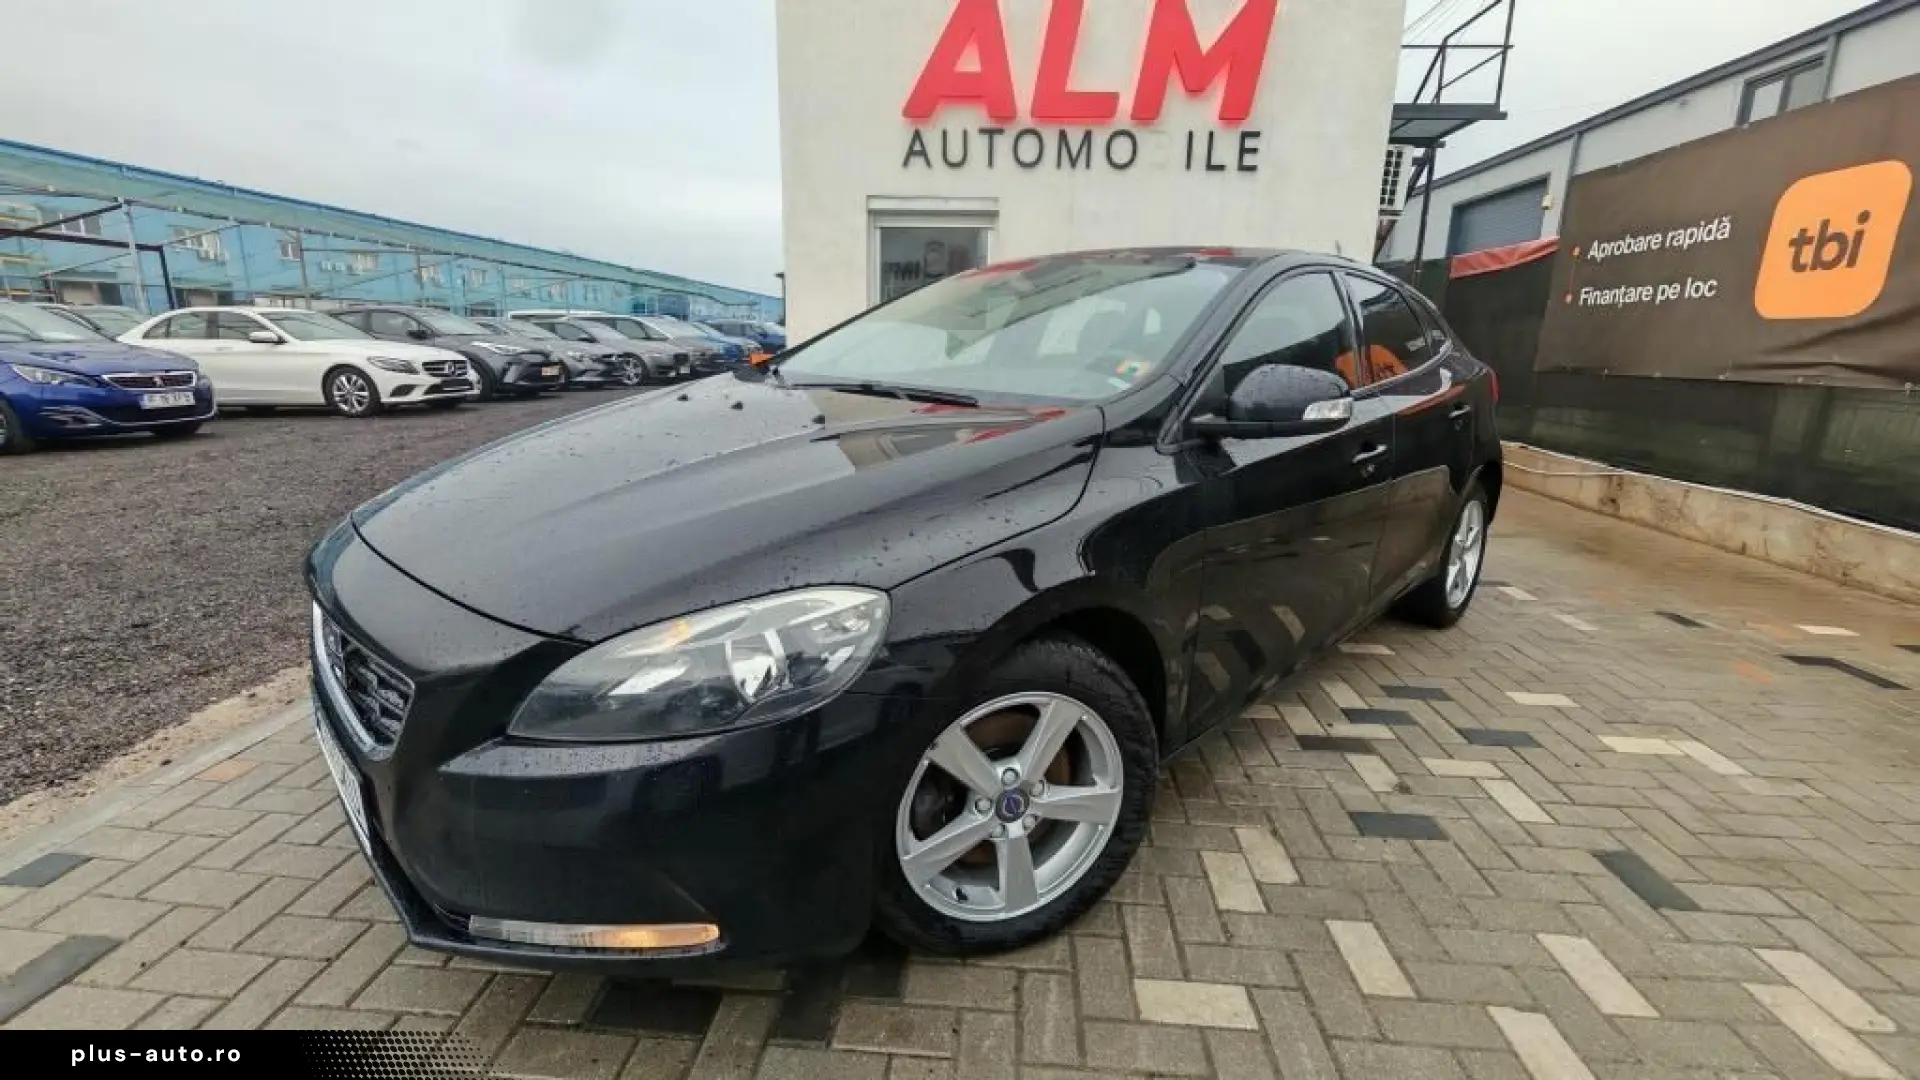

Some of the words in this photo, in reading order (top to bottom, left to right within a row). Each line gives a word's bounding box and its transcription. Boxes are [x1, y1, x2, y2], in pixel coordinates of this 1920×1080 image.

[902, 0, 1278, 121] ALM
[902, 128, 1261, 171] AUTOMOILE
[1587, 233, 1662, 263] Aprobare
[1665, 215, 1732, 250] rapidă
[1788, 209, 1872, 273] tbi
[1655, 282, 1681, 305] pe
[1684, 276, 1718, 299] loc
